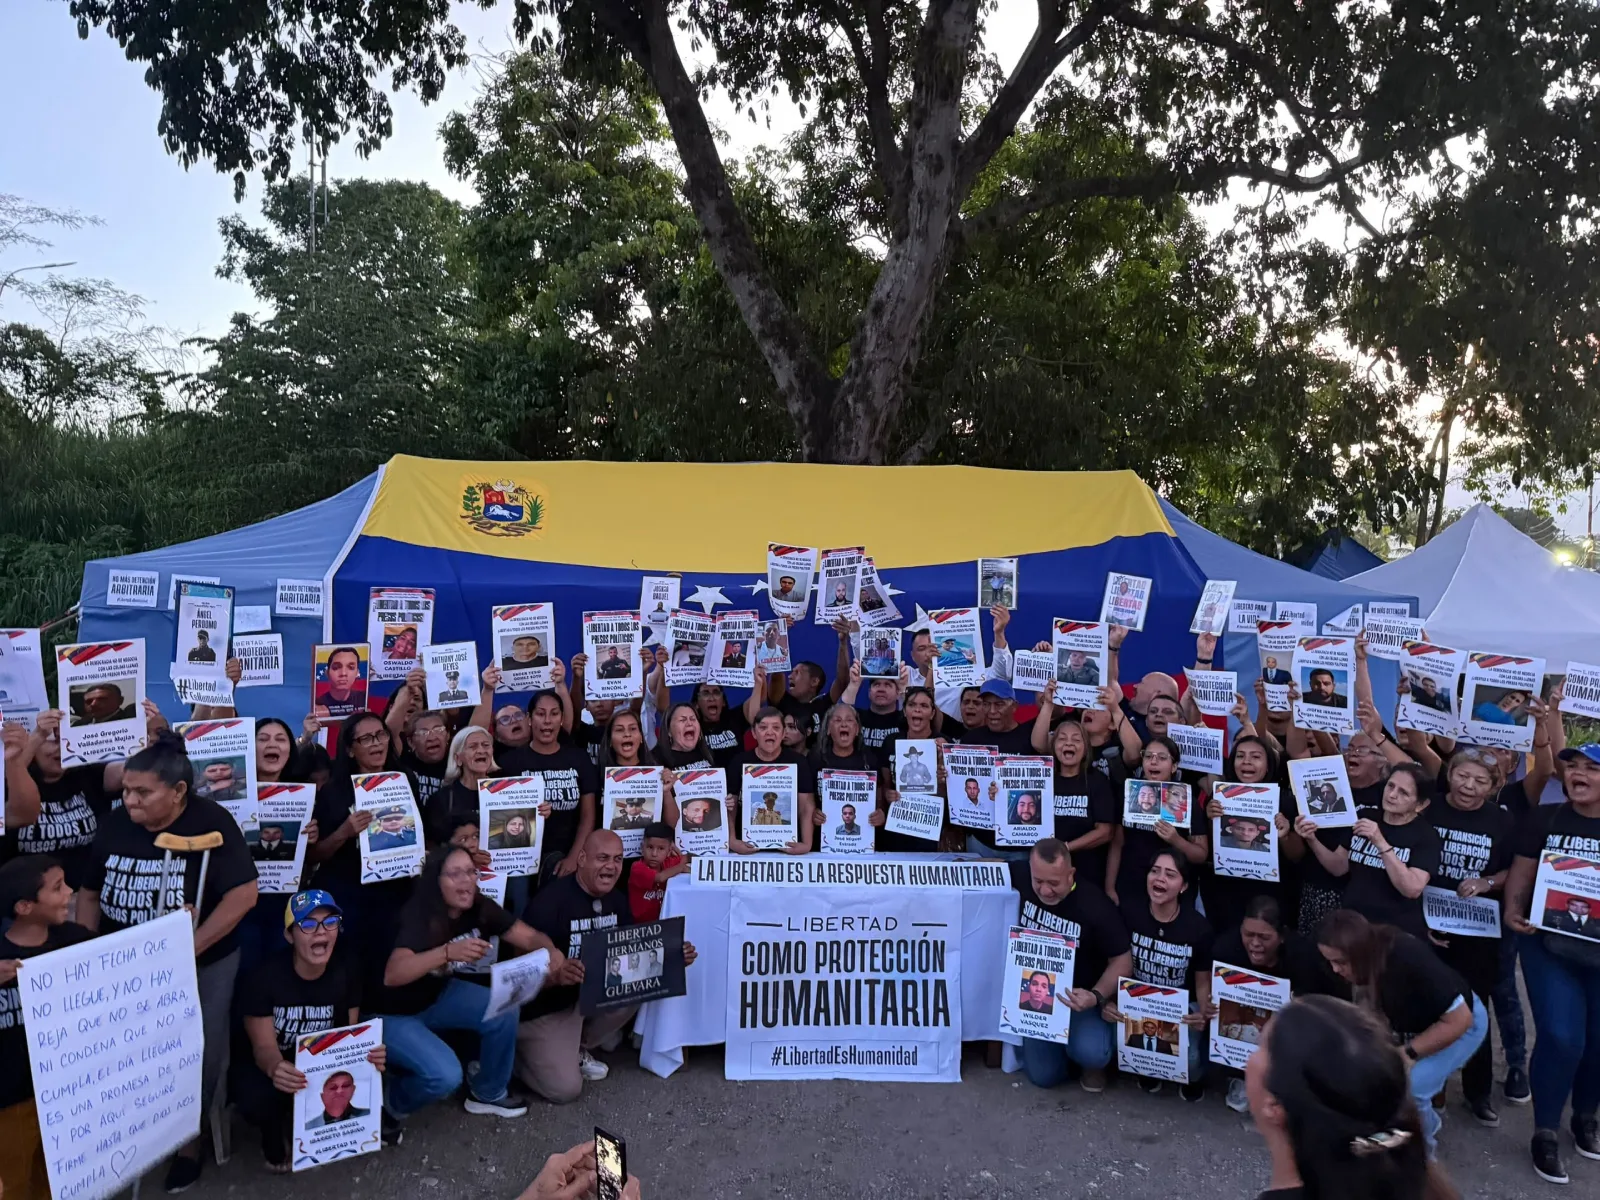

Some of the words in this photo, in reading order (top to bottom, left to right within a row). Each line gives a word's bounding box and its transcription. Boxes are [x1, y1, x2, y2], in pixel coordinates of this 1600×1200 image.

[120, 575, 130, 583] MÁS
[131, 576, 156, 586] DETENCIÓN
[111, 583, 154, 597] ARBITRARIA
[287, 584, 297, 592] MÁS
[298, 585, 320, 593] DETENCIÓN
[280, 593, 320, 604] ARBITRARIA
[191, 619, 218, 630] PERDOMO
[1238, 614, 1246, 623] LA
[610, 622, 615, 632] A
[616, 622, 630, 632] TODOS
[630, 621, 639, 631] LOS
[1383, 624, 1418, 637] PROTECCIÓN
[591, 635, 609, 645] PRESOS
[238, 645, 278, 658] PROTECCIÓN
[1017, 658, 1032, 667] COMO
[1197, 679, 1233, 691] PROTECCIÓN
[1567, 672, 1588, 686] COMO
[1186, 737, 1219, 749] PROTECCIÓN
[968, 756, 973, 765] A
[543, 768, 579, 781] TRANSICIÓN
[1021, 768, 1026, 777] A
[1026, 768, 1041, 777] TODOS
[1042, 768, 1051, 777] LOS
[847, 781, 851, 790] A
[1003, 780, 1020, 789] PRESOS
[910, 801, 940, 815] PROTECCIÓN
[891, 807, 940, 828] HUMANITARIA
[17, 824, 35, 841] DE
[38, 821, 81, 841] TODOS
[1448, 829, 1492, 848] TRANSICIÓN
[17, 840, 57, 853] PRESOS
[1350, 836, 1366, 851] SIN
[1443, 841, 1491, 859] LIBERACIÓN
[105, 854, 120, 869] NO
[118, 856, 135, 872] HAY
[1350, 852, 1364, 863] HAY
[1467, 856, 1489, 871] LOS
[698, 859, 715, 882] LA
[719, 859, 783, 883] LIBERTAD
[788, 861, 804, 883] ES
[808, 861, 825, 884] LA
[828, 862, 904, 886] RESPUESTA
[909, 864, 1005, 887] HUMANITARIA
[115, 872, 127, 891] LA
[112, 889, 154, 909] TODOS
[166, 890, 185, 909] OS
[1427, 895, 1449, 908] COMO
[1449, 899, 1494, 917] PROTECCIÓN
[1023, 900, 1037, 920] SIN
[1037, 908, 1082, 938] LIBERTAD
[1427, 904, 1496, 926] HUMANITARIA
[570, 919, 580, 932] NO
[579, 918, 591, 930] HAY
[787, 917, 898, 932] LIBERTAD
[569, 932, 582, 947] SIN
[607, 924, 662, 944] LIBERTAD
[567, 946, 581, 960] DE
[607, 938, 663, 958] HERMANOS
[741, 940, 807, 976] COMO
[815, 931, 945, 976] PROTECCIÓN
[1010, 940, 1038, 956] ¡LIBERTAD
[1038, 946, 1043, 956] A
[1043, 946, 1061, 959] TODOS
[1062, 948, 1072, 960] LOS
[1139, 935, 1152, 949] HAY
[1154, 938, 1193, 958] TRANSICIÓN
[31, 973, 53, 992] NO
[65, 961, 90, 983] HAY
[99, 948, 137, 970] FECHA
[144, 939, 167, 956] QUE
[1014, 954, 1035, 970] PRESOS
[1139, 948, 1148, 959] LA
[1150, 951, 1189, 970] LIBERACIÓN
[1140, 959, 1169, 977] TODOS
[33, 1003, 52, 1019] NO
[112, 982, 119, 1000] Y
[124, 977, 142, 995] NO
[151, 968, 174, 988] HAY
[606, 976, 661, 998] GUEVARA
[739, 979, 950, 1029] HUMANITARIA
[286, 1006, 303, 1020] HAY
[1022, 1012, 1047, 1021] WILDER
[37, 1027, 68, 1050] REJA
[78, 1016, 102, 1033] QUE
[110, 1008, 127, 1024] NO
[137, 1000, 150, 1015] SE
[285, 1019, 299, 1033] LA
[1020, 1018, 1048, 1028] VASQUEZ
[40, 1060, 53, 1073] NI
[60, 1038, 116, 1068] CONDENA
[124, 1025, 147, 1043] QUE
[157, 1014, 175, 1028] NO
[771, 1045, 918, 1067] #LibertadEsHumanidad
[98, 1068, 110, 1080] EL
[46, 1110, 64, 1126] ES
[71, 1099, 93, 1116] UNA
[101, 1074, 149, 1102] PROMESA
[158, 1066, 171, 1078] DE
[52, 1134, 60, 1150] Y
[70, 1122, 91, 1142] POR
[96, 1130, 121, 1153] HASTA
[60, 1165, 106, 1199] CUMPLA
